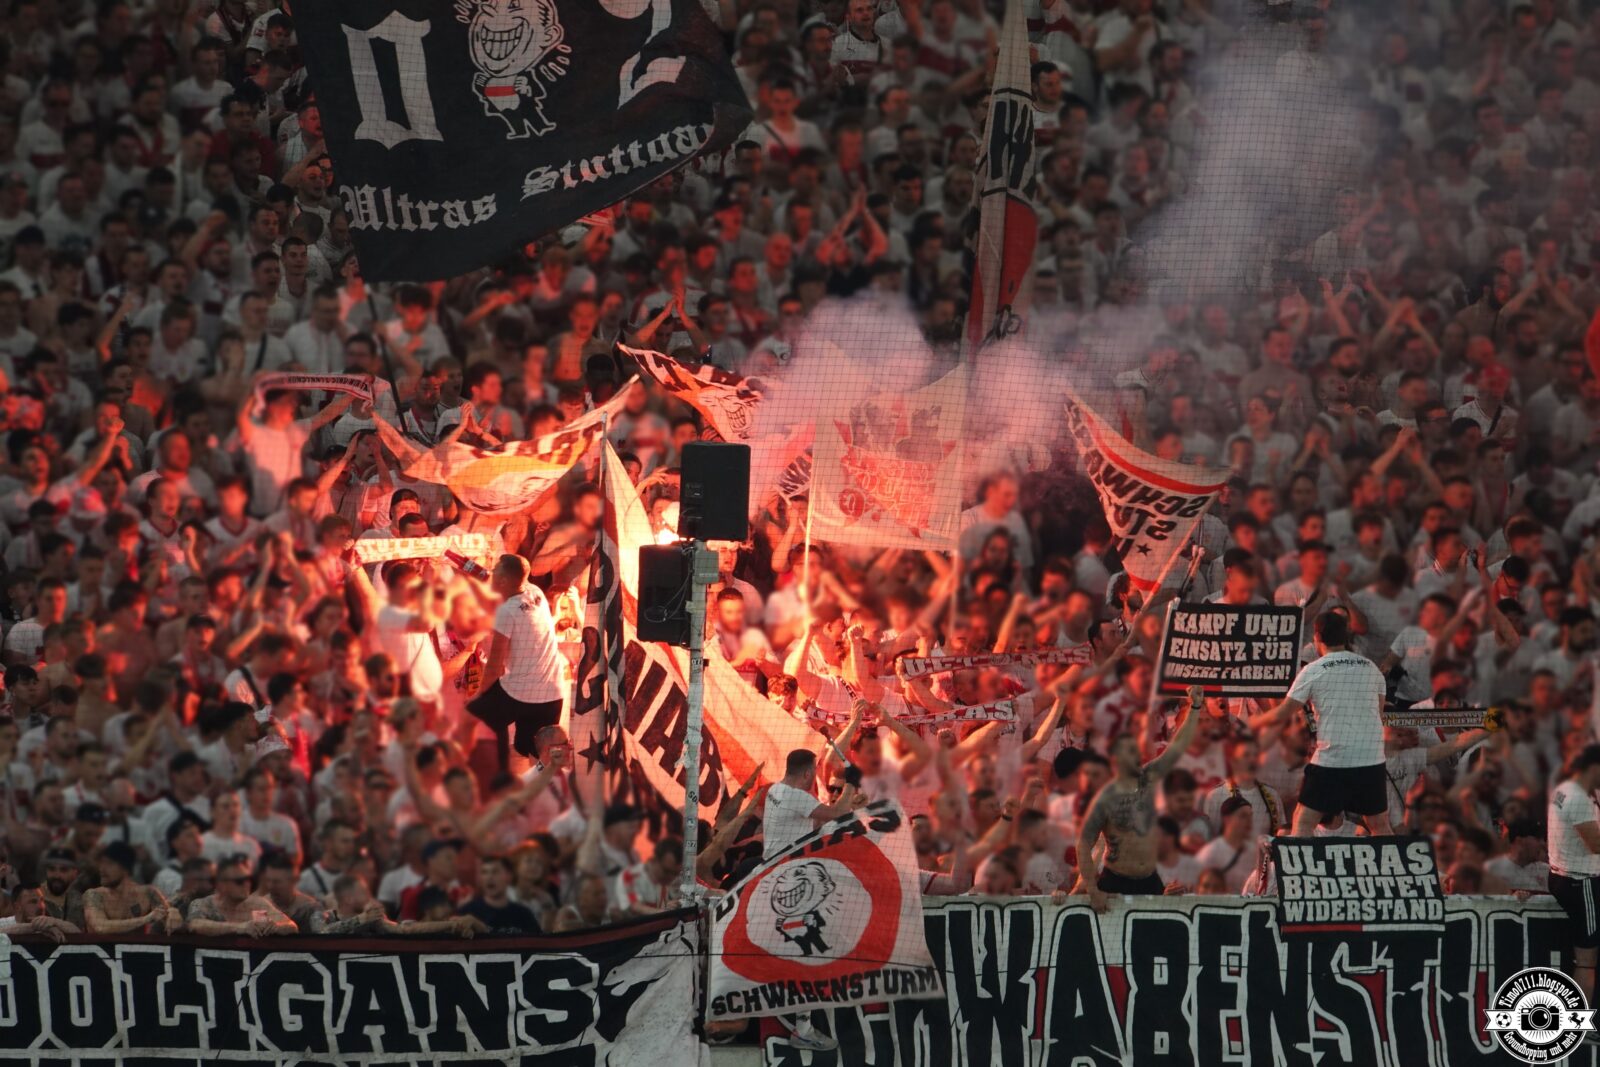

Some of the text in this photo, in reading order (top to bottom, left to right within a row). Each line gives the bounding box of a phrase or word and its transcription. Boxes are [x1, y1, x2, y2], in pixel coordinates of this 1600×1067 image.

[339, 123, 714, 232] Ultras Stuttgar
[1173, 613, 1296, 636] KAMPF UND
[1169, 636, 1293, 661] EINSATZ FÜR
[1165, 662, 1290, 680] UNSERE FARBEN!
[1278, 843, 1434, 875] ULTRAS
[1283, 874, 1438, 900] BEDEUTET
[1283, 899, 1443, 923] WIDERSTAND
[710, 967, 938, 1017] SCHWABENSTURM
